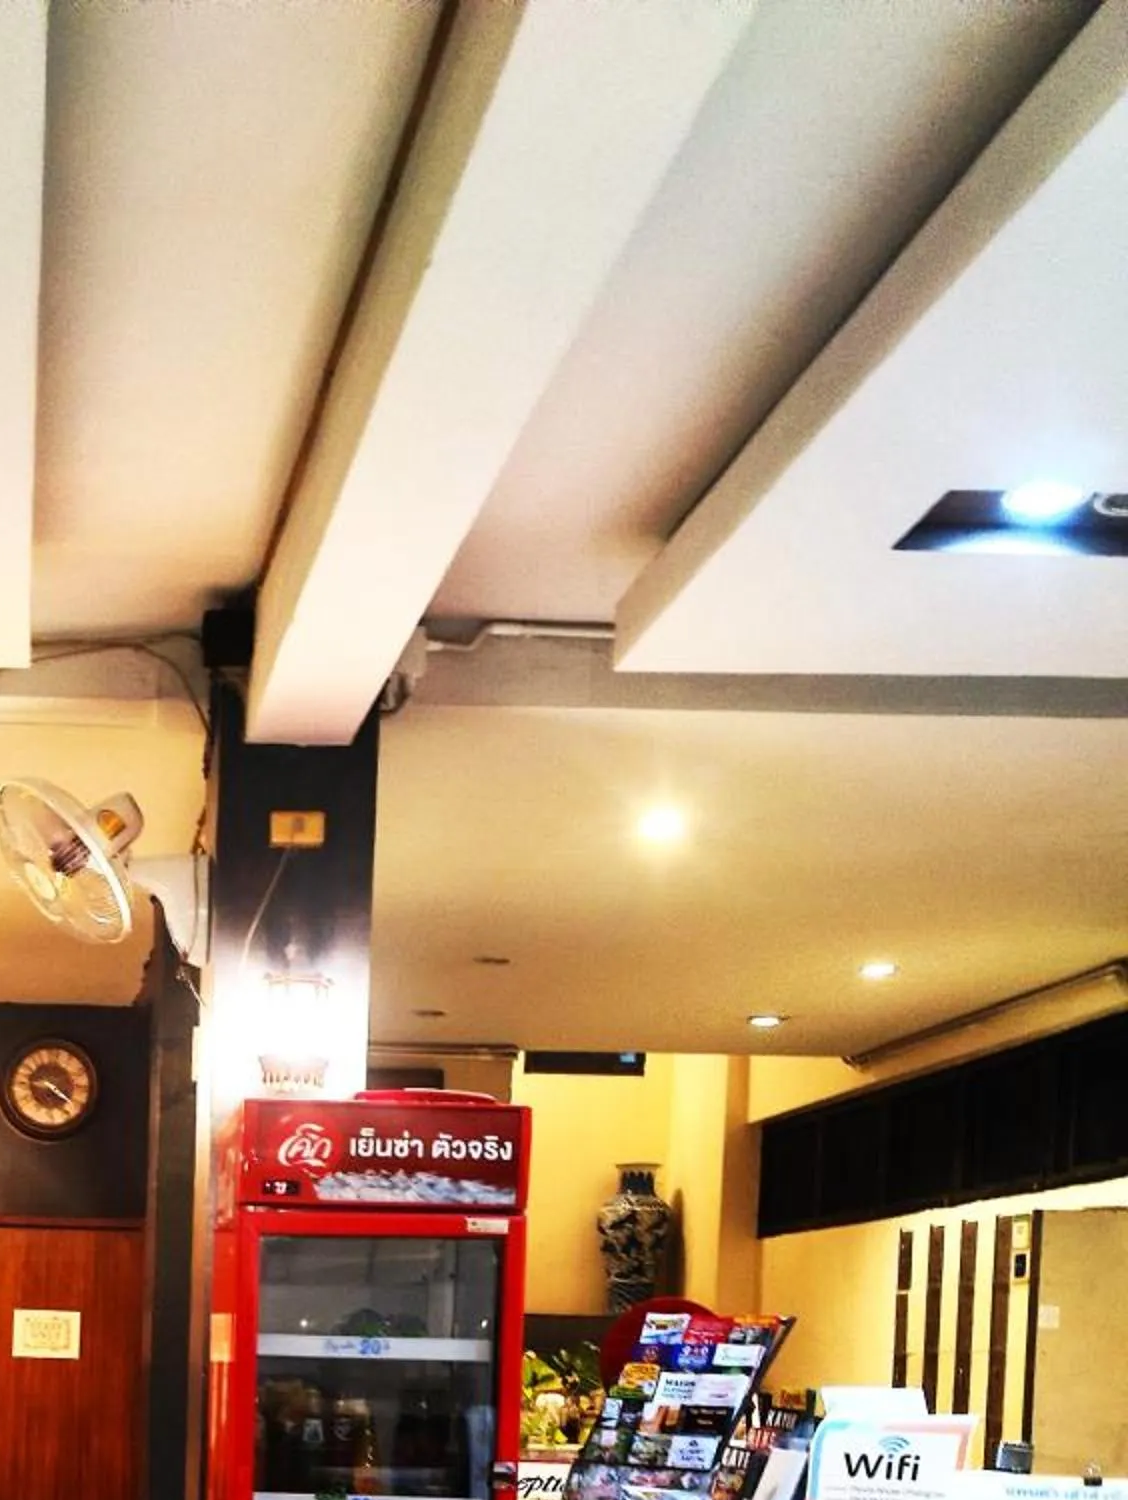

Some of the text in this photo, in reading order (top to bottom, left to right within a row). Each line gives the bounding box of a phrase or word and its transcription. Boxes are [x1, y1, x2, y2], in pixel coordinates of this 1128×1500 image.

[350, 1127, 513, 1161] เย็นซ่า ตัวจริง
[844, 1452, 920, 1481] Wifi
